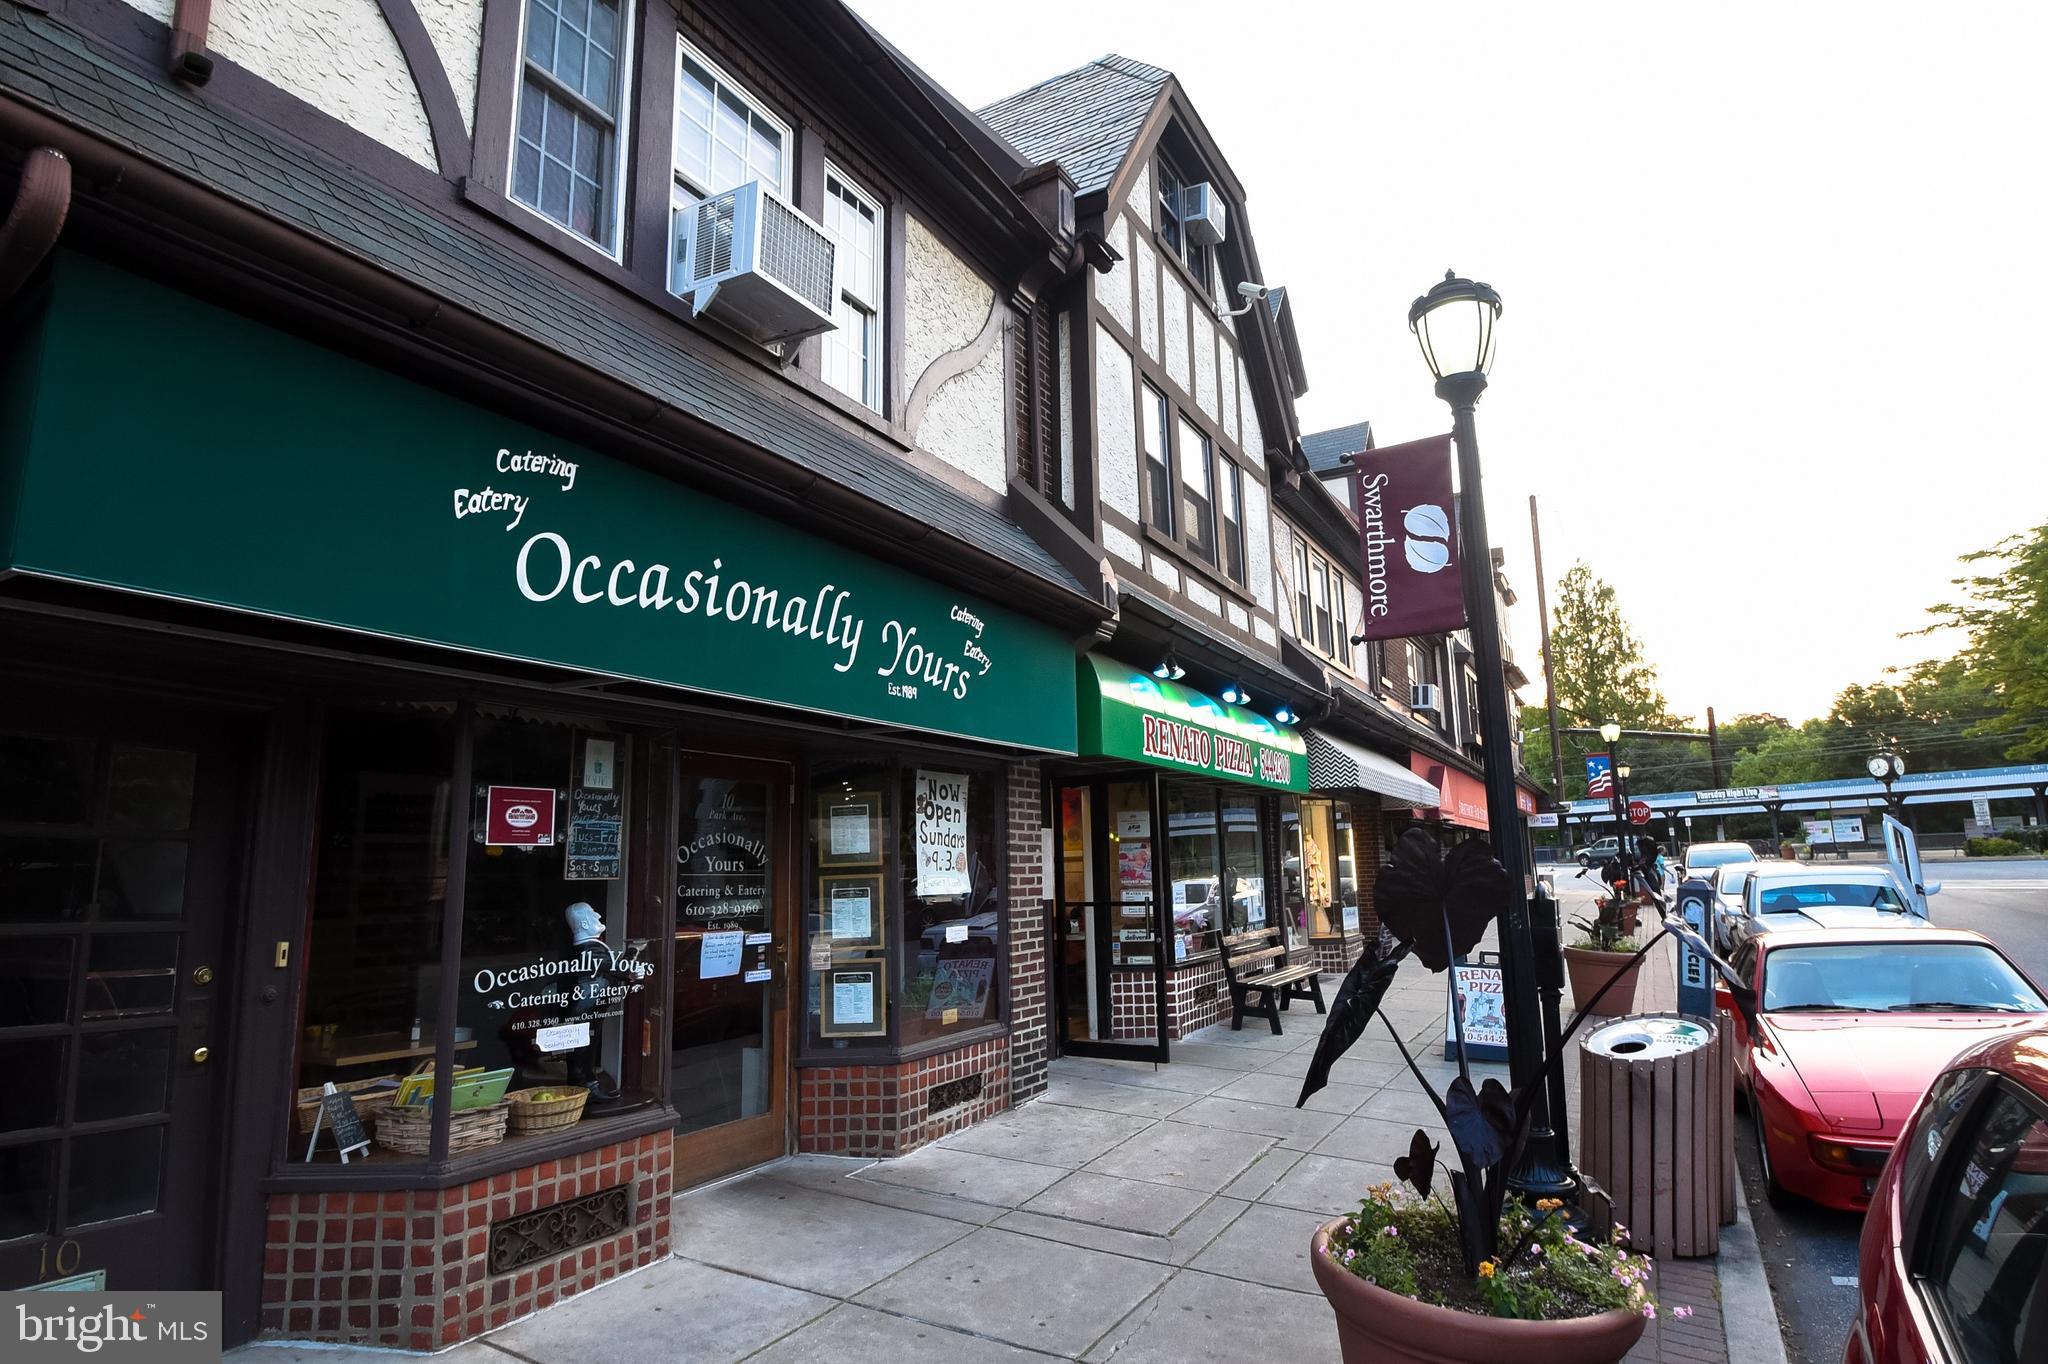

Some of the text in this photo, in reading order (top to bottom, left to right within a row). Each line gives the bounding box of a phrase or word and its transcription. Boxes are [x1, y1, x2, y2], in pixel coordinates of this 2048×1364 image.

[496, 448, 580, 491] Catering
[453, 487, 528, 531] Eatery
[1363, 473, 1395, 617] Swarthmore
[516, 530, 970, 700] Occasionally Yours
[950, 605, 985, 638] Catering
[963, 639, 992, 676] Eatery
[1143, 715, 1211, 767] RENATO
[1213, 735, 1254, 776] PIZZA
[1696, 788, 1758, 800] Thursday Night Live
[709, 809, 727, 820] Park
[924, 799, 961, 828] Open
[1629, 807, 1649, 817] STOP
[677, 826, 769, 867] Occasionally
[705, 856, 745, 873] Yours
[677, 885, 767, 899] Catering & Eatery
[685, 902, 759, 918] 610-328-9360
[707, 921, 739, 931] Est. 1989
[474, 950, 655, 994] Occasionally Yours
[1459, 969, 1503, 981] RENA
[508, 984, 630, 1009] Catering & Eatery
[1469, 981, 1502, 994] PIZZ
[564, 1009, 624, 1023] www.OccYours.com
[39, 1240, 81, 1280] 10
